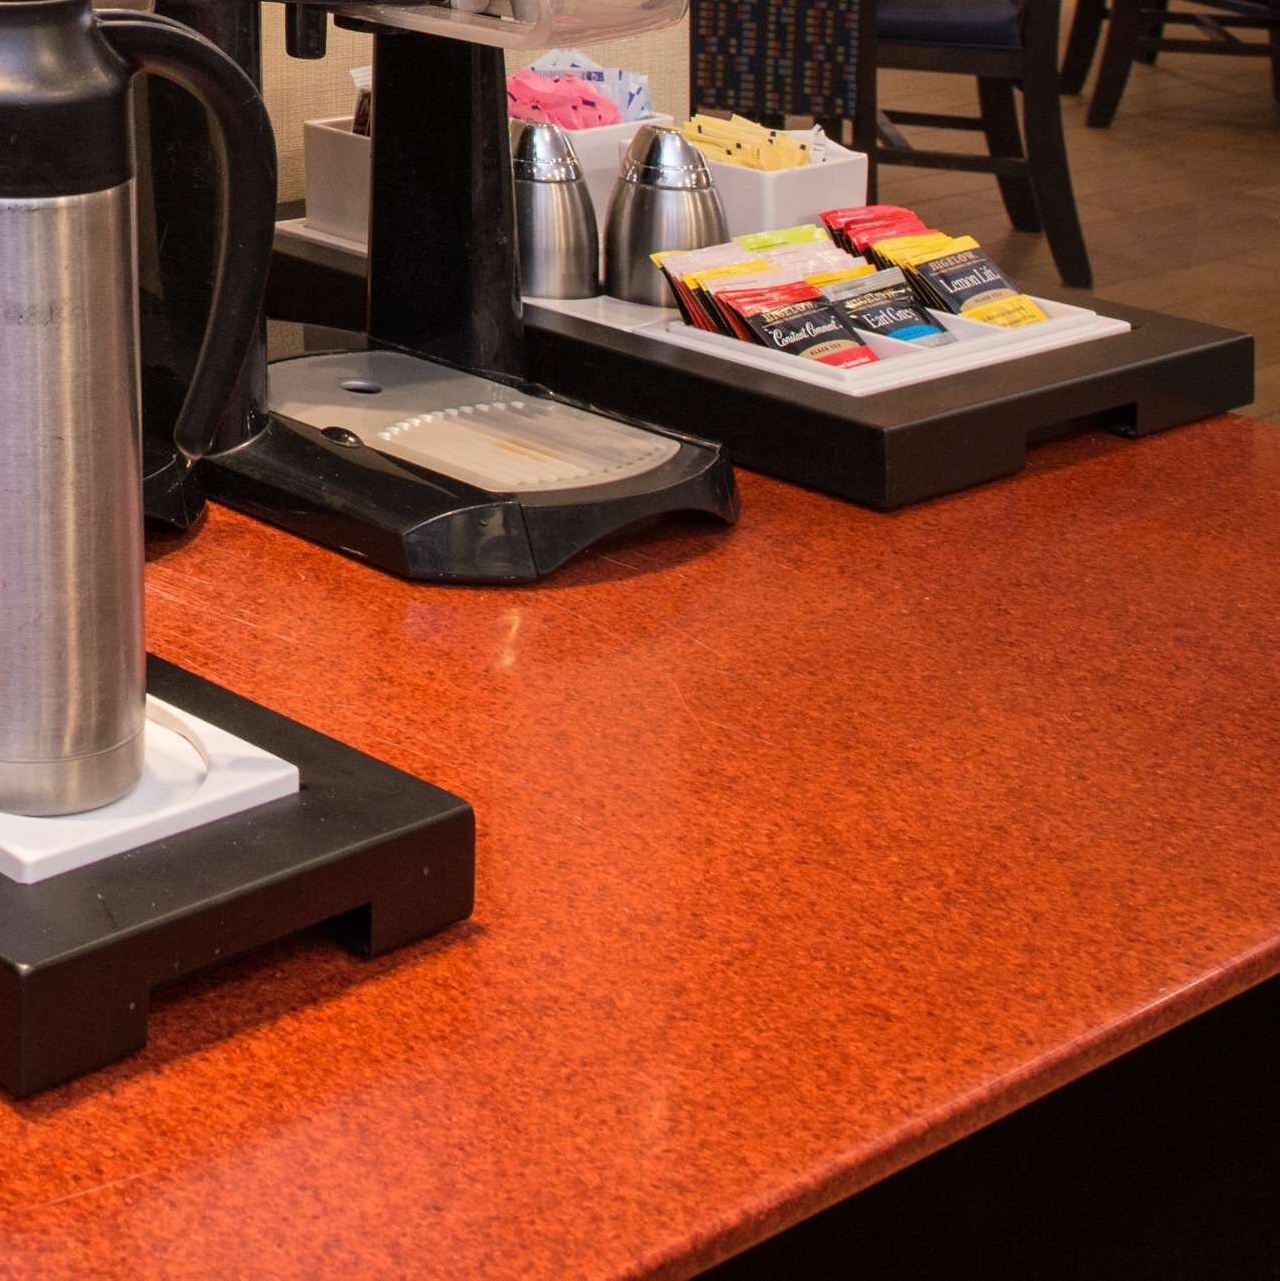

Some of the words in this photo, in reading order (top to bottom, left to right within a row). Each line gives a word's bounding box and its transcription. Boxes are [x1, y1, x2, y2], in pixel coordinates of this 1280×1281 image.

[928, 250, 976, 272] BIGELOW
[939, 273, 980, 294] Lemon
[762, 300, 815, 324] BIGELOW
[862, 309, 891, 329] Earl
[886, 306, 917, 321] Grey
